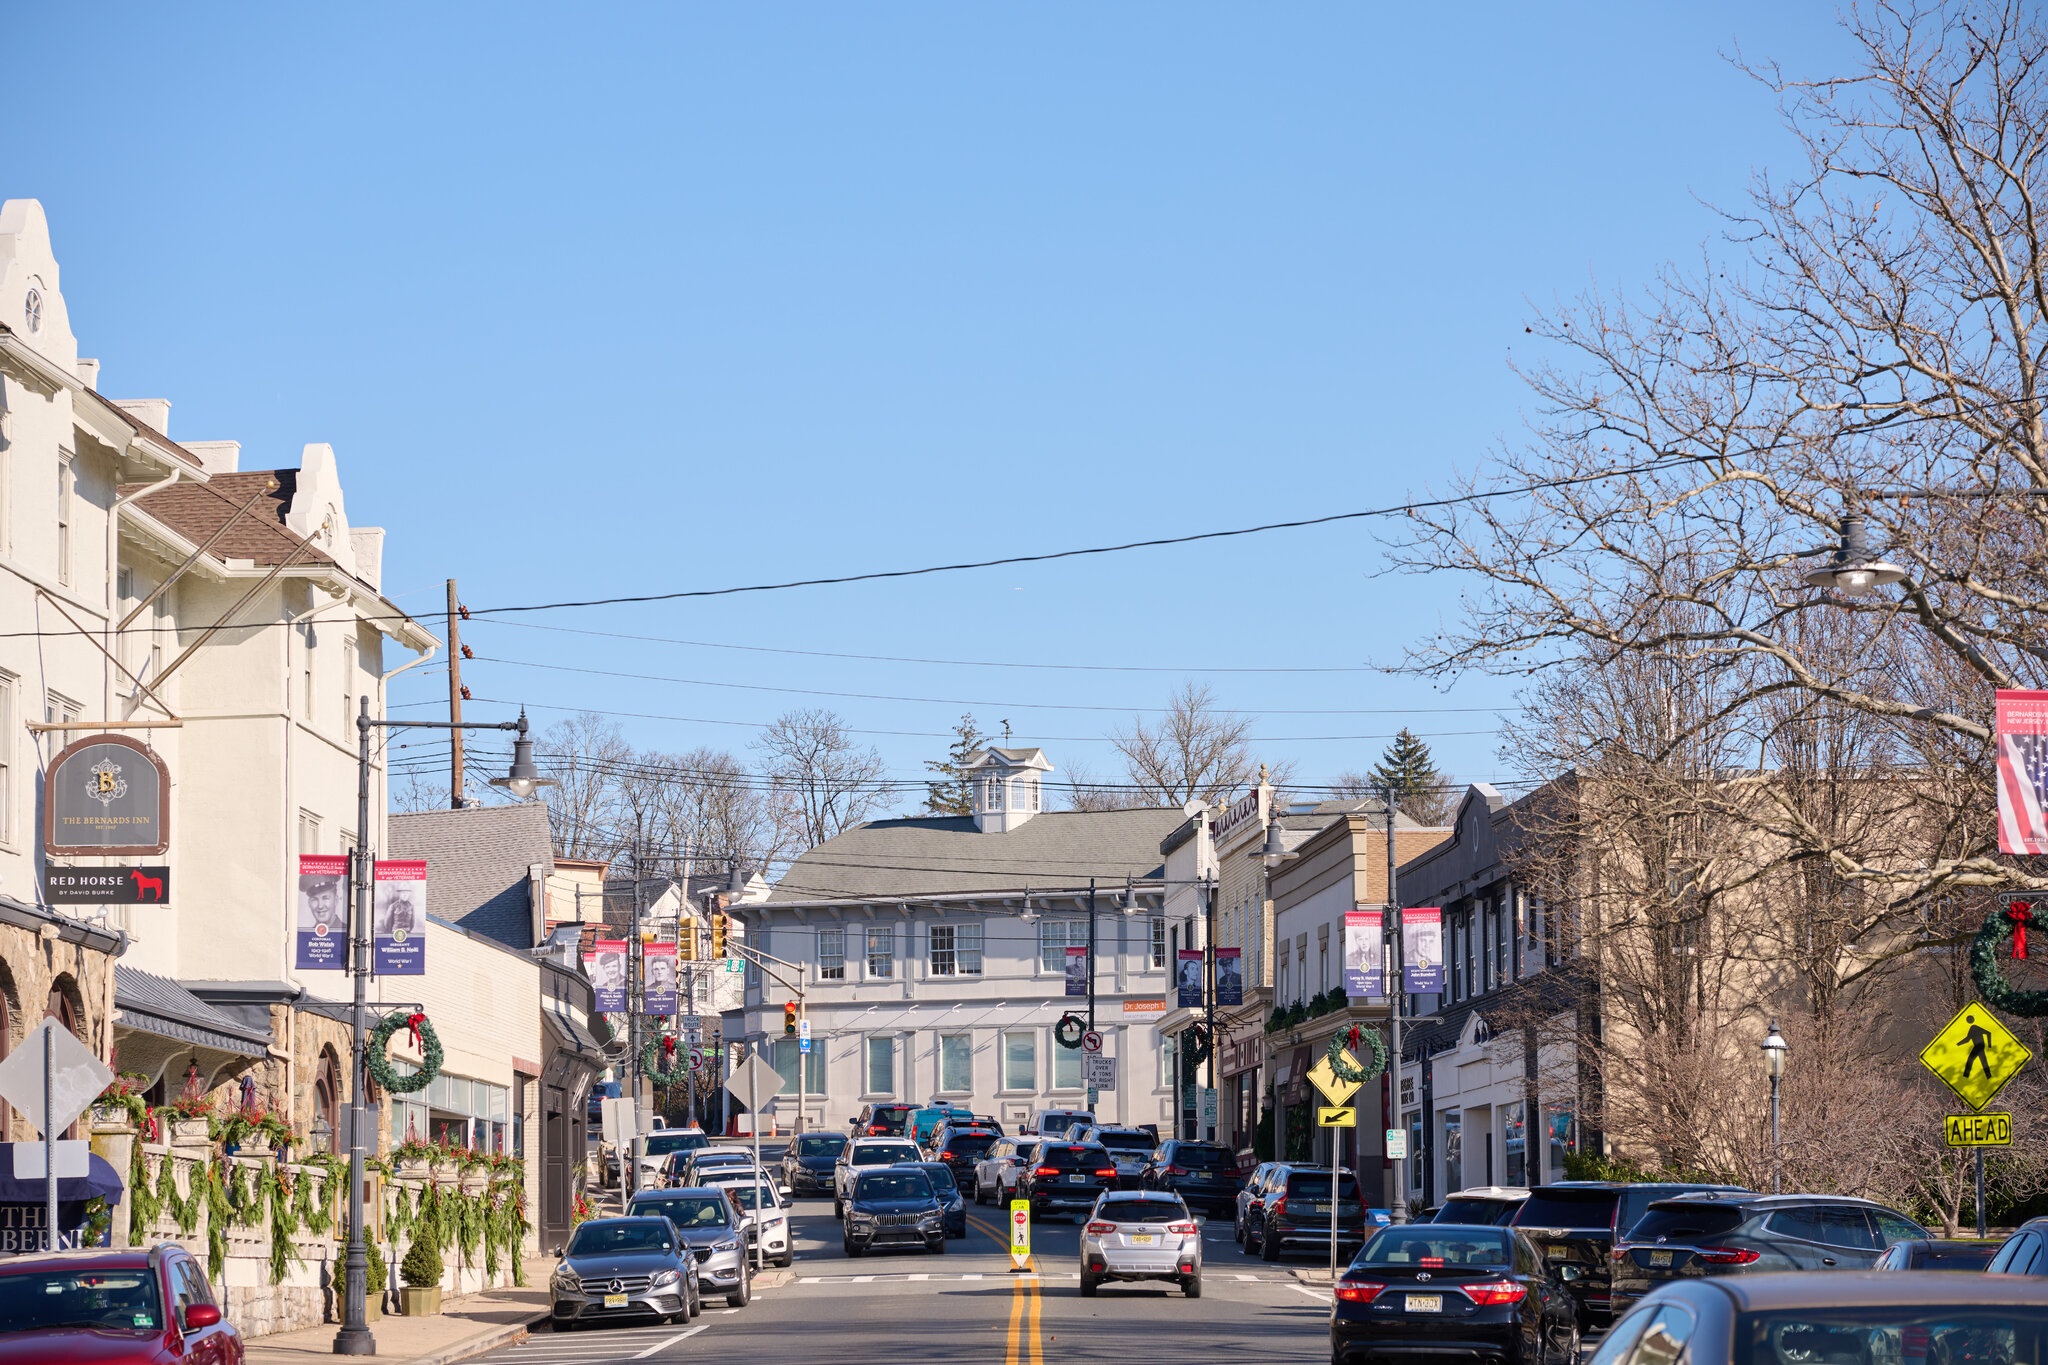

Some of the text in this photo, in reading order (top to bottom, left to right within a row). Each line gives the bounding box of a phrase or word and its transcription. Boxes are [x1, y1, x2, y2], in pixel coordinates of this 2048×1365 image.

[63, 816, 150, 825] THE BERNARDS INN
[50, 876, 124, 886] RED HORSE
[1124, 1003, 1133, 1011] Dr.
[1135, 1002, 1159, 1011] Joseph
[1951, 1119, 2008, 1141] AHEAD
